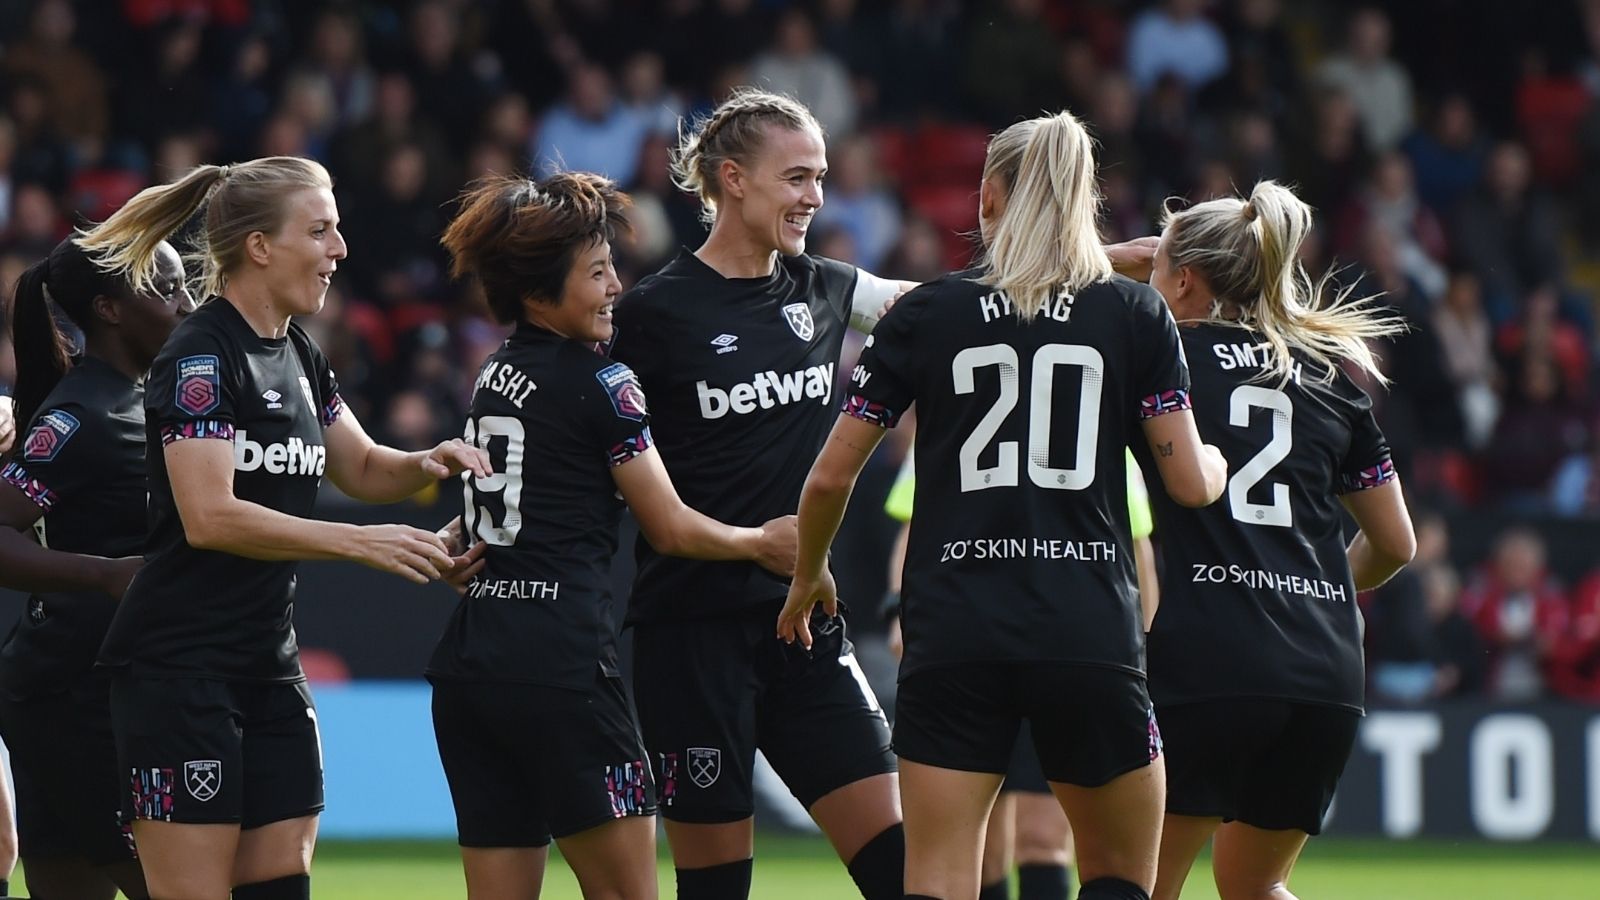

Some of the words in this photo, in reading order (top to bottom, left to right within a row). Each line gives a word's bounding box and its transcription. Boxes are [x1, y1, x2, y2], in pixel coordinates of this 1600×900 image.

[980, 290, 1074, 322] KYAG
[471, 361, 537, 409] ASHI
[696, 362, 834, 419] betway
[952, 343, 1104, 492] 20
[235, 430, 326, 477] betwa
[1229, 385, 1293, 527] 2
[461, 416, 525, 548] 19
[974, 538, 1026, 559] SKIN
[1033, 538, 1116, 562] HEALTH
[1193, 564, 1227, 583] ZO
[1275, 573, 1347, 602] HEALTH
